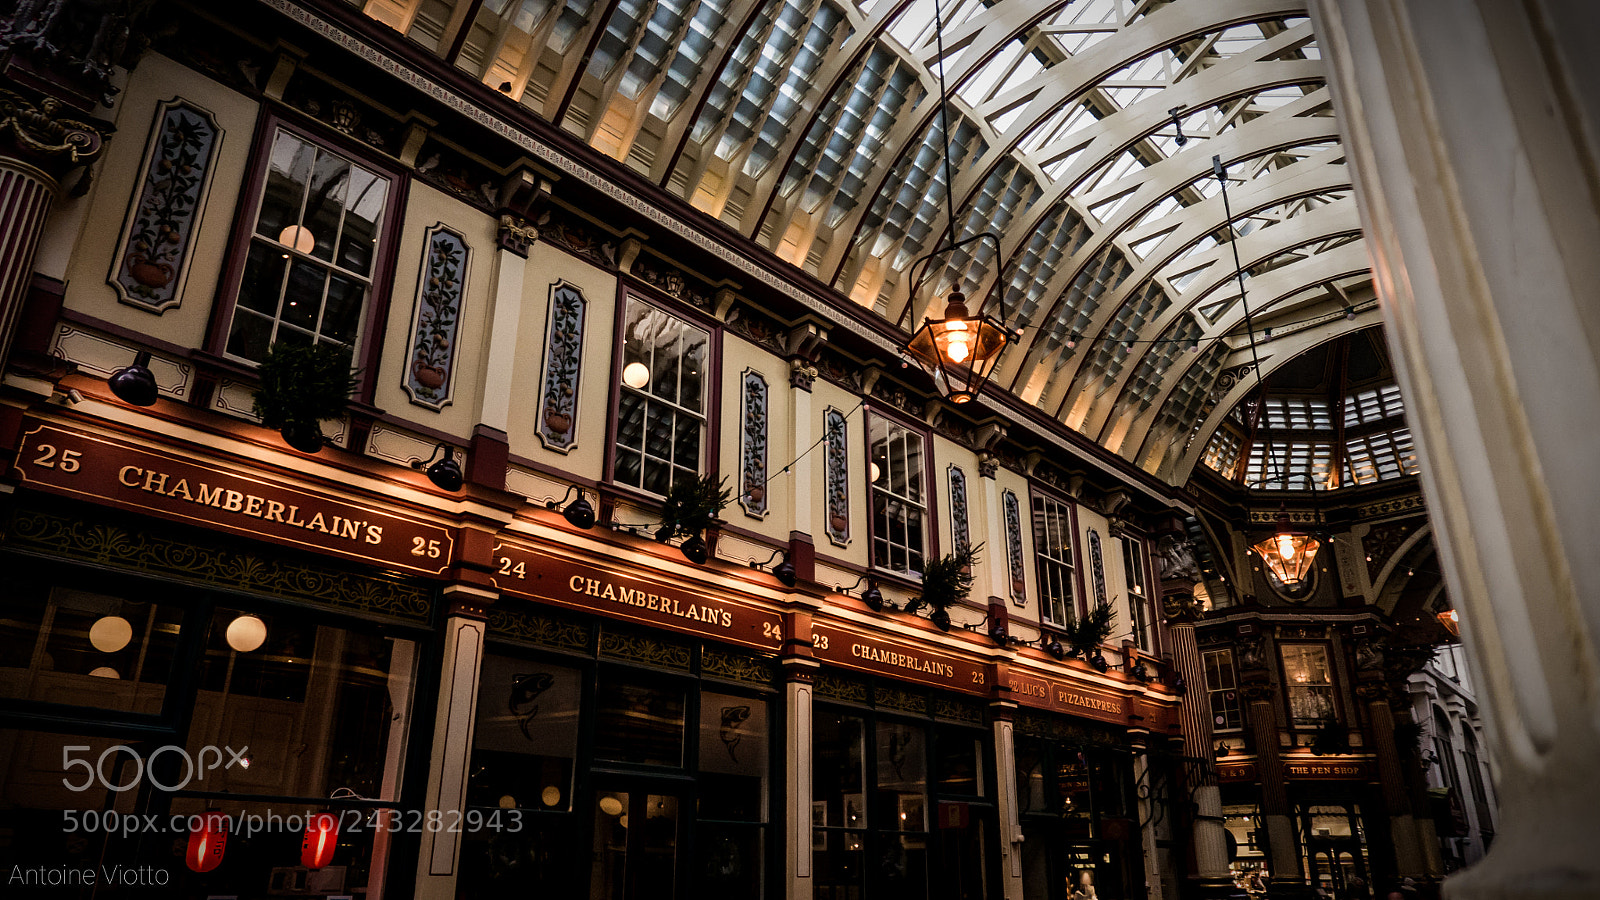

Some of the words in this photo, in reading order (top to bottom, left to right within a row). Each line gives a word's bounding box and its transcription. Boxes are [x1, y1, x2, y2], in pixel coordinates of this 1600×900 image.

[33, 443, 83, 474] 25
[118, 464, 383, 544] CHAMBERLAIN'S
[410, 536, 443, 560] 25
[498, 557, 527, 581] 24
[569, 575, 733, 629] CHAMBERLAIN'S
[762, 621, 783, 641] 24
[812, 633, 829, 650] 23
[852, 643, 954, 678] CHAMBERLAIN'S
[971, 671, 985, 686] 23
[1022, 683, 1046, 698] LUC'S
[1058, 691, 1122, 715] PIZZAEXPRESS
[1239, 768, 1246, 777] 9
[1290, 766, 1309, 775] THE
[1312, 766, 1332, 775] PEN
[1334, 766, 1360, 775] SHOP
